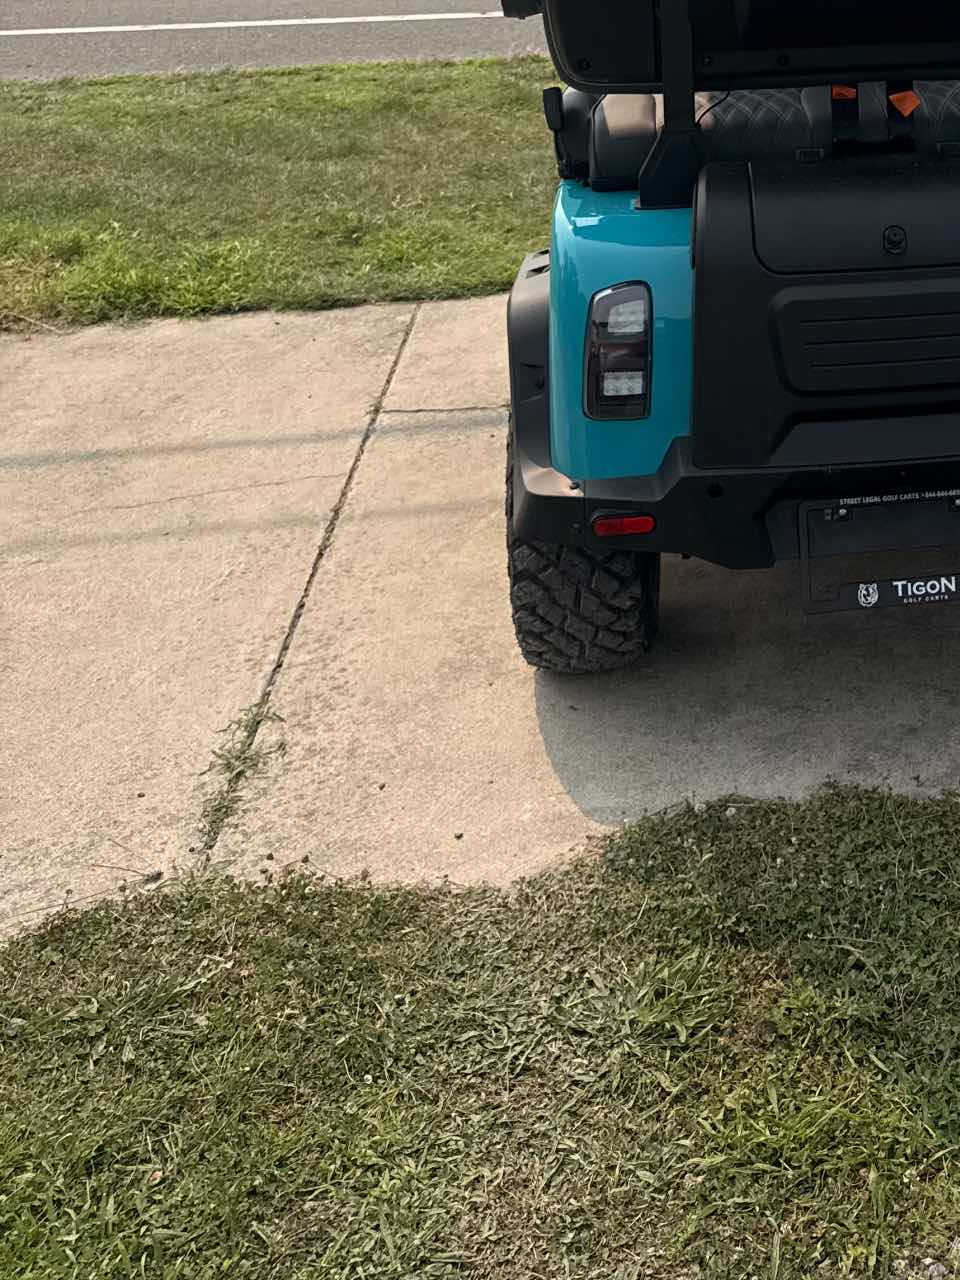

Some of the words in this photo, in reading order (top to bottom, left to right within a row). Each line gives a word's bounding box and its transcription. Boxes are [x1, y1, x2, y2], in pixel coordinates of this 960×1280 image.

[863, 495, 881, 503] LEGAL
[882, 494, 898, 502] GOLF
[899, 492, 919, 500] CARTS
[893, 576, 956, 596] TIGON
[904, 596, 921, 604] GOLF
[925, 594, 948, 602] CARTS
